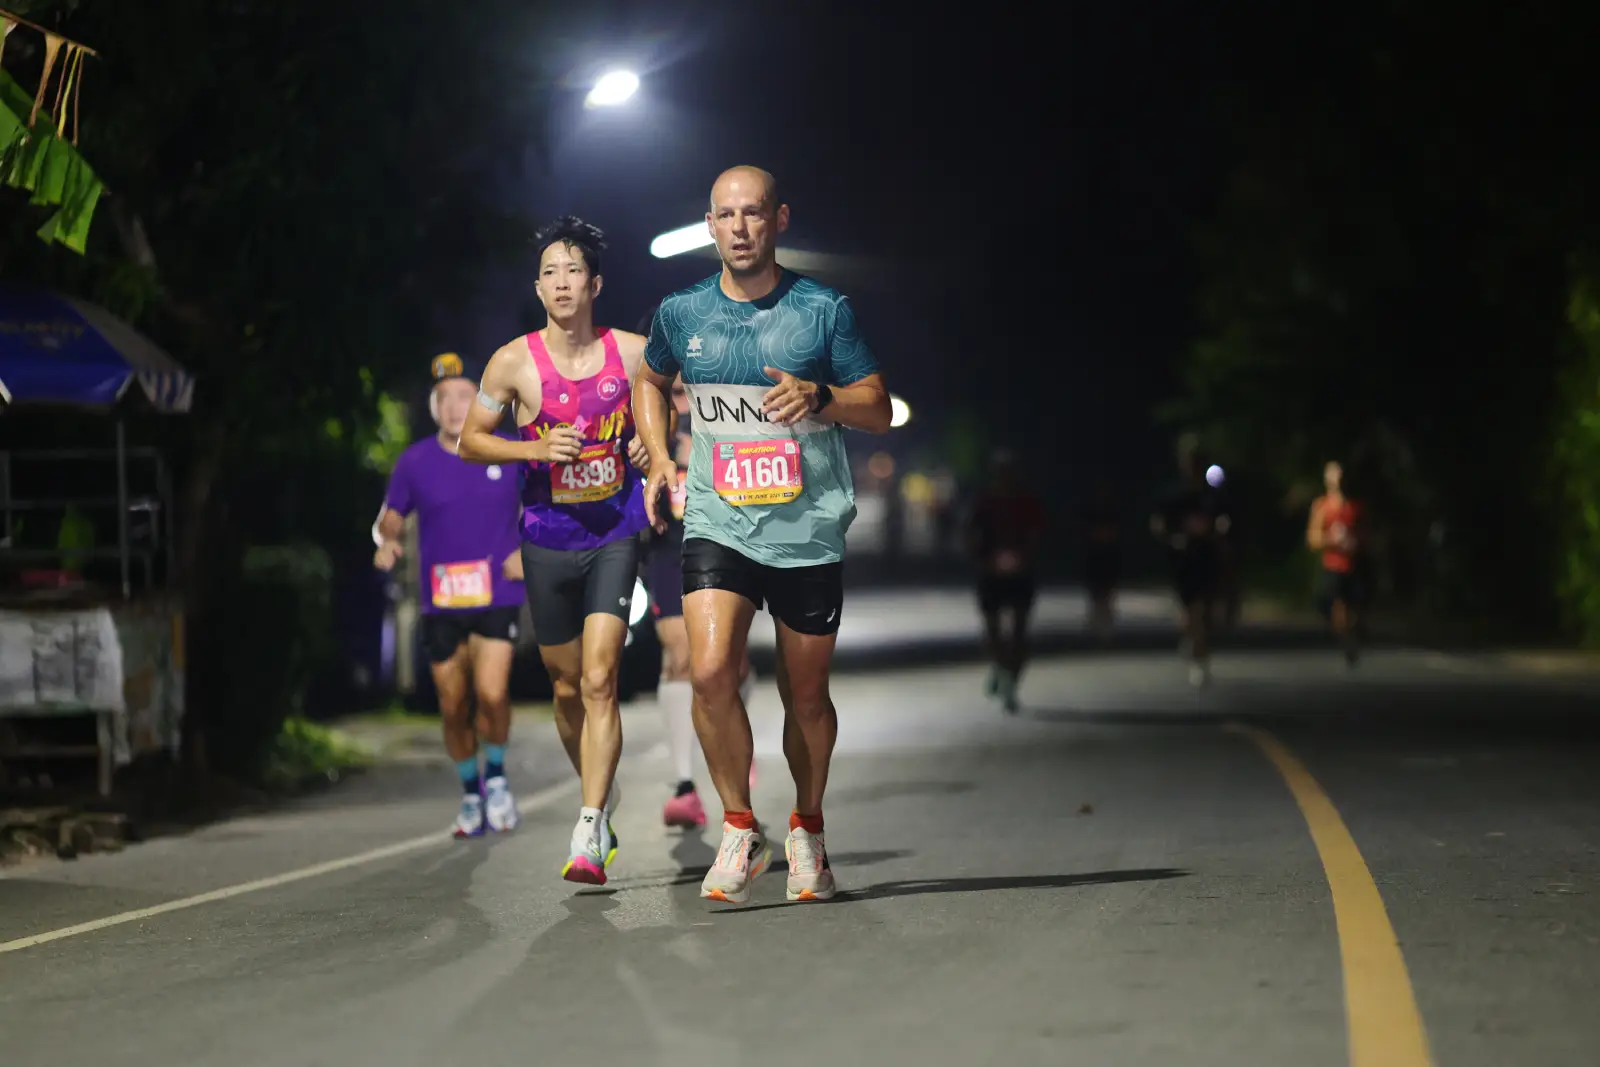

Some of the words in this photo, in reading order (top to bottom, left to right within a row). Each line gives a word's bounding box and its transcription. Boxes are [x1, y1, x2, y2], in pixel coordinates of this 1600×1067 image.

[696, 396, 771, 423] UNN
[738, 446, 776, 455] MARATHON
[561, 456, 617, 490] 4398
[724, 456, 788, 489] 4160
